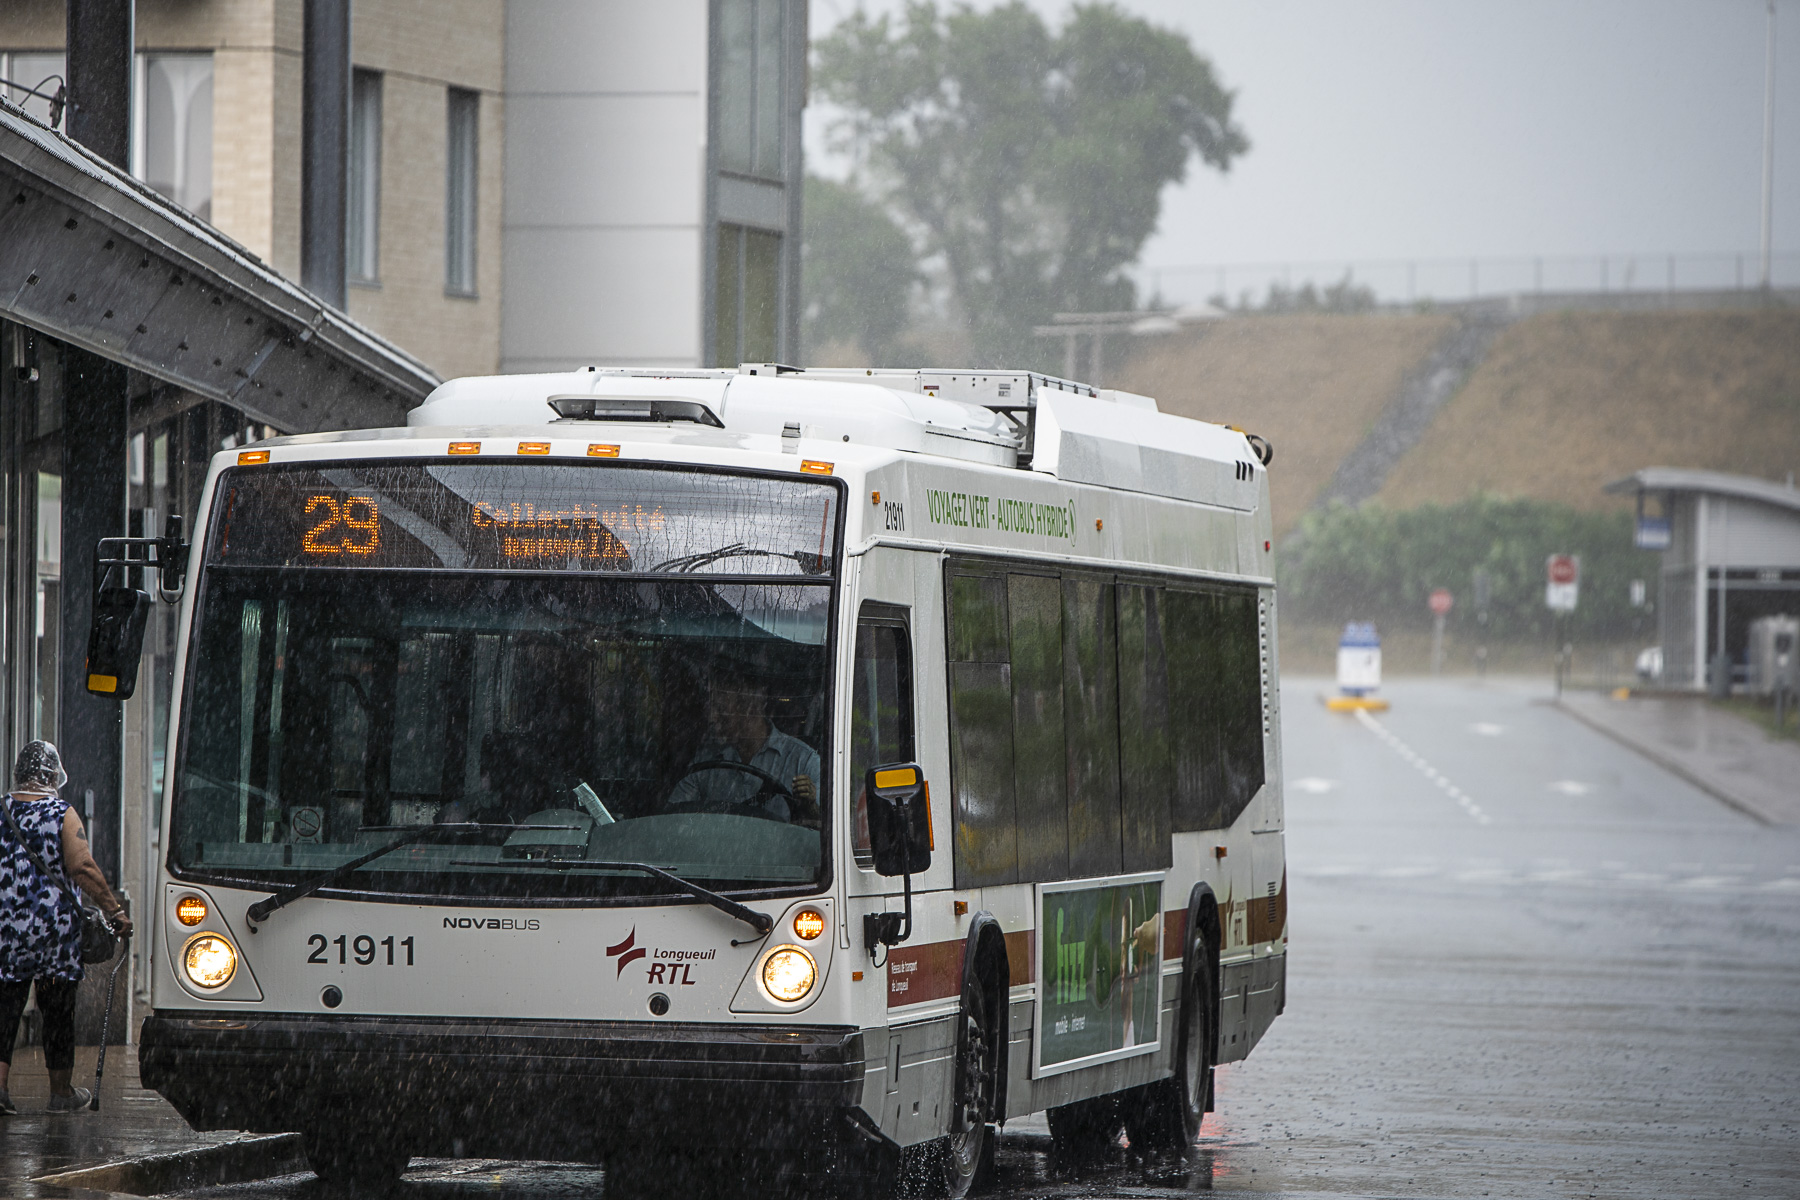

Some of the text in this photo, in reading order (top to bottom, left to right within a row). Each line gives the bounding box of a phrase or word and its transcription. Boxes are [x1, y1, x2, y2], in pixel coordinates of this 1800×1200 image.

[302, 495, 381, 554] 29
[884, 501, 905, 532] 21911
[927, 488, 968, 527] VOYAGEZ
[968, 494, 990, 529] VERT
[998, 498, 1035, 535] AUTOBUS
[1035, 503, 1069, 538] HYBRIDE
[307, 933, 415, 966] 21911
[653, 948, 716, 962] Longueuil
[1056, 907, 1087, 1005] fizz
[646, 962, 696, 985] RTL
